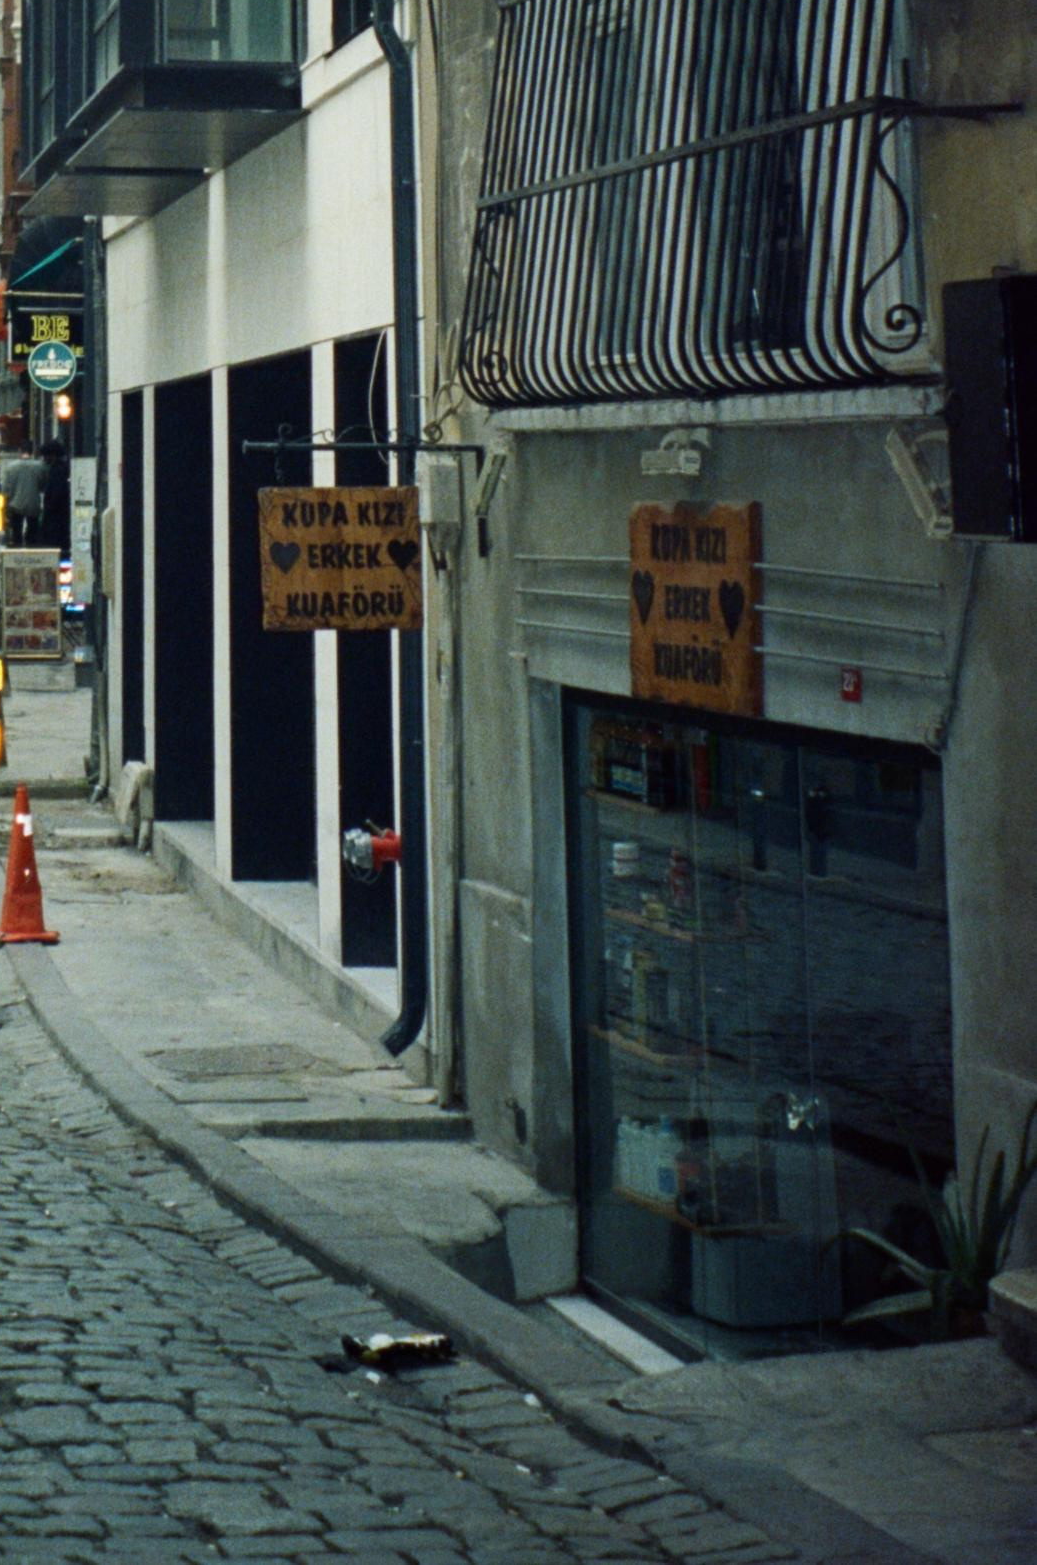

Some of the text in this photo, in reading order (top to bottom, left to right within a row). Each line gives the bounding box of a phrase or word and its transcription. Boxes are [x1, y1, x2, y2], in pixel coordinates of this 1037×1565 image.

[31, 314, 70, 341] BE
[282, 501, 405, 527] KUPA KIZI
[307, 542, 382, 569] ERKEK
[651, 523, 727, 565] KUPA KIZI
[286, 585, 404, 618] KUAFÖRÜ
[664, 584, 711, 622] ERKEK
[654, 634, 723, 685] KUAFÖRÜ
